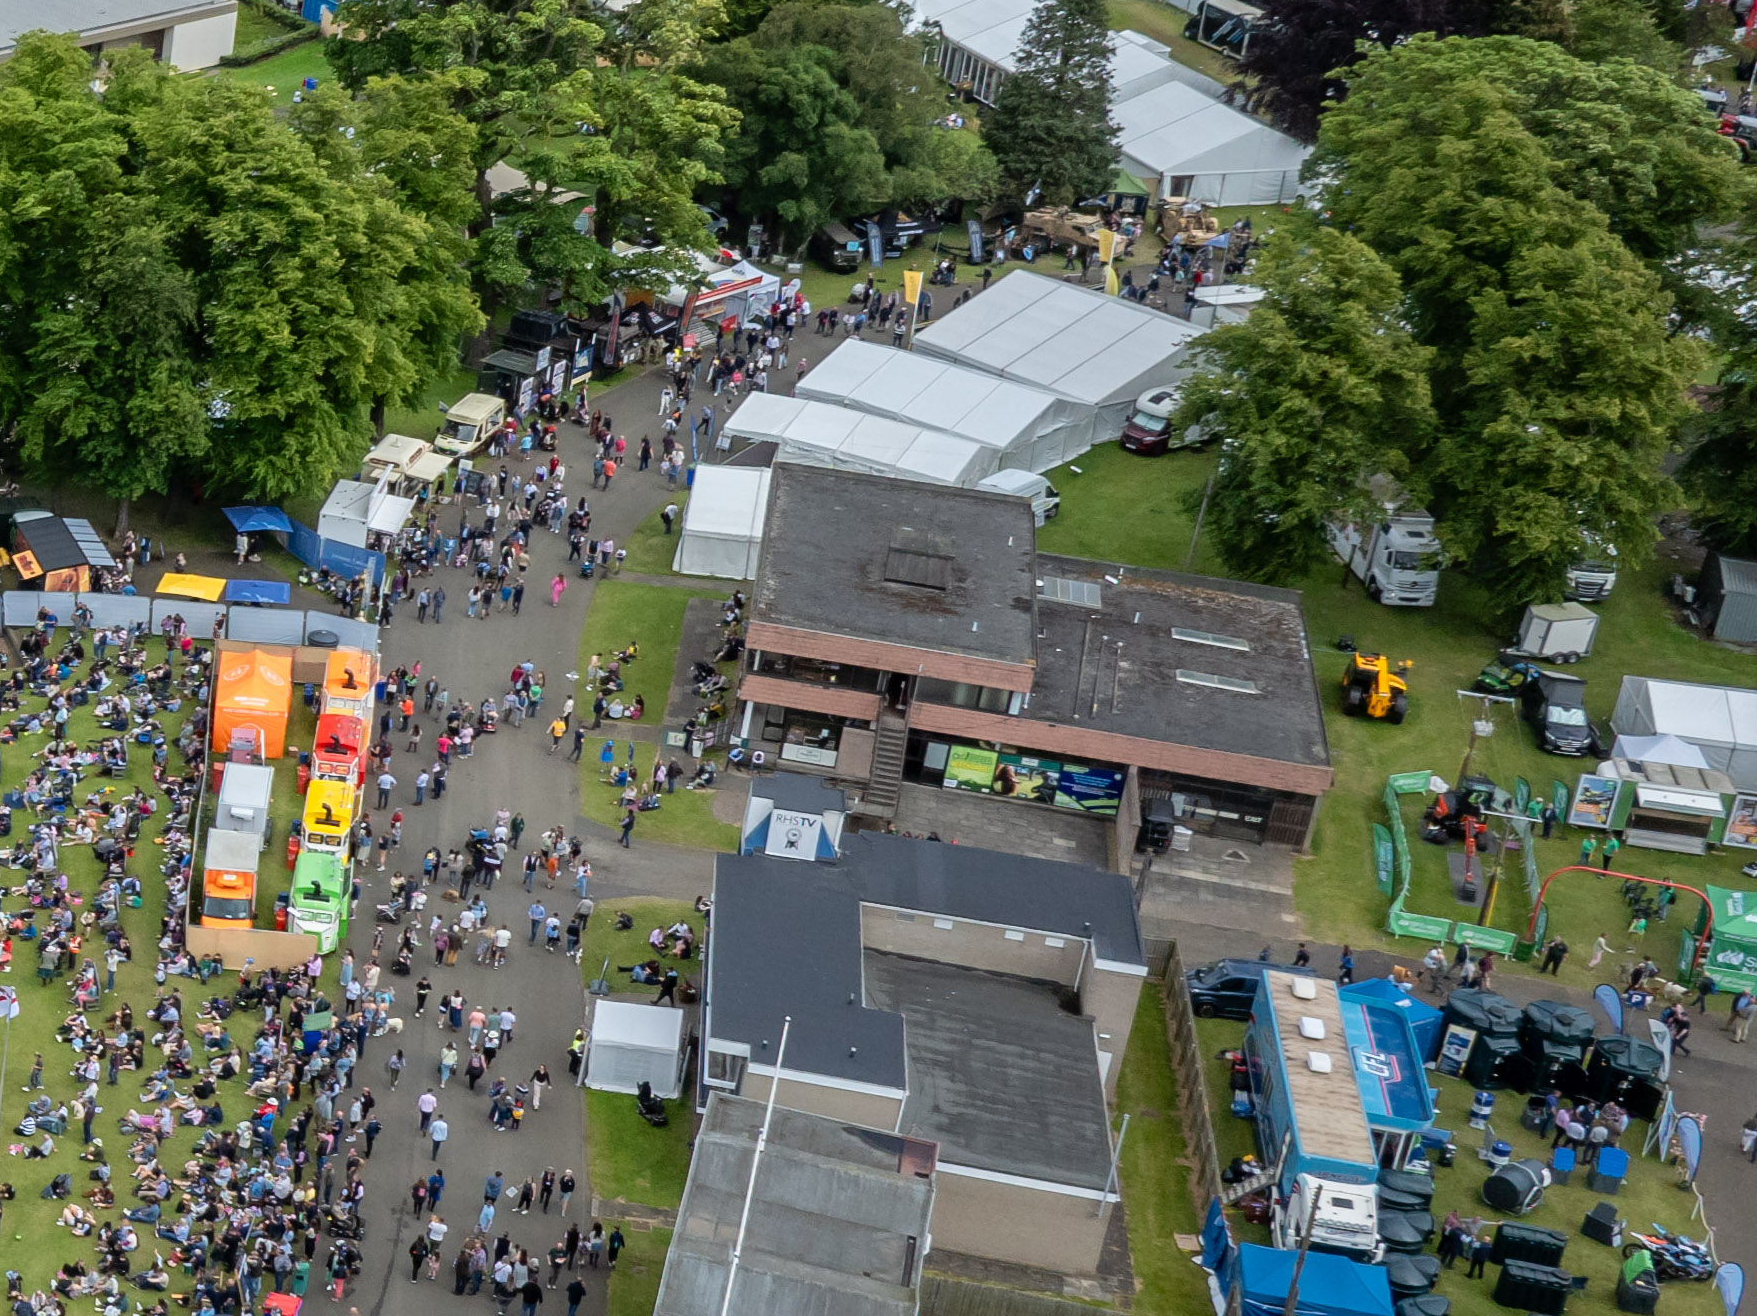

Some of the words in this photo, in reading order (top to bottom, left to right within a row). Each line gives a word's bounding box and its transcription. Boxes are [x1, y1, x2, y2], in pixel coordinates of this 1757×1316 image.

[776, 813, 817, 827] RHSTV
[1631, 994, 1642, 1003] P
[1360, 1050, 1390, 1077] CFL
